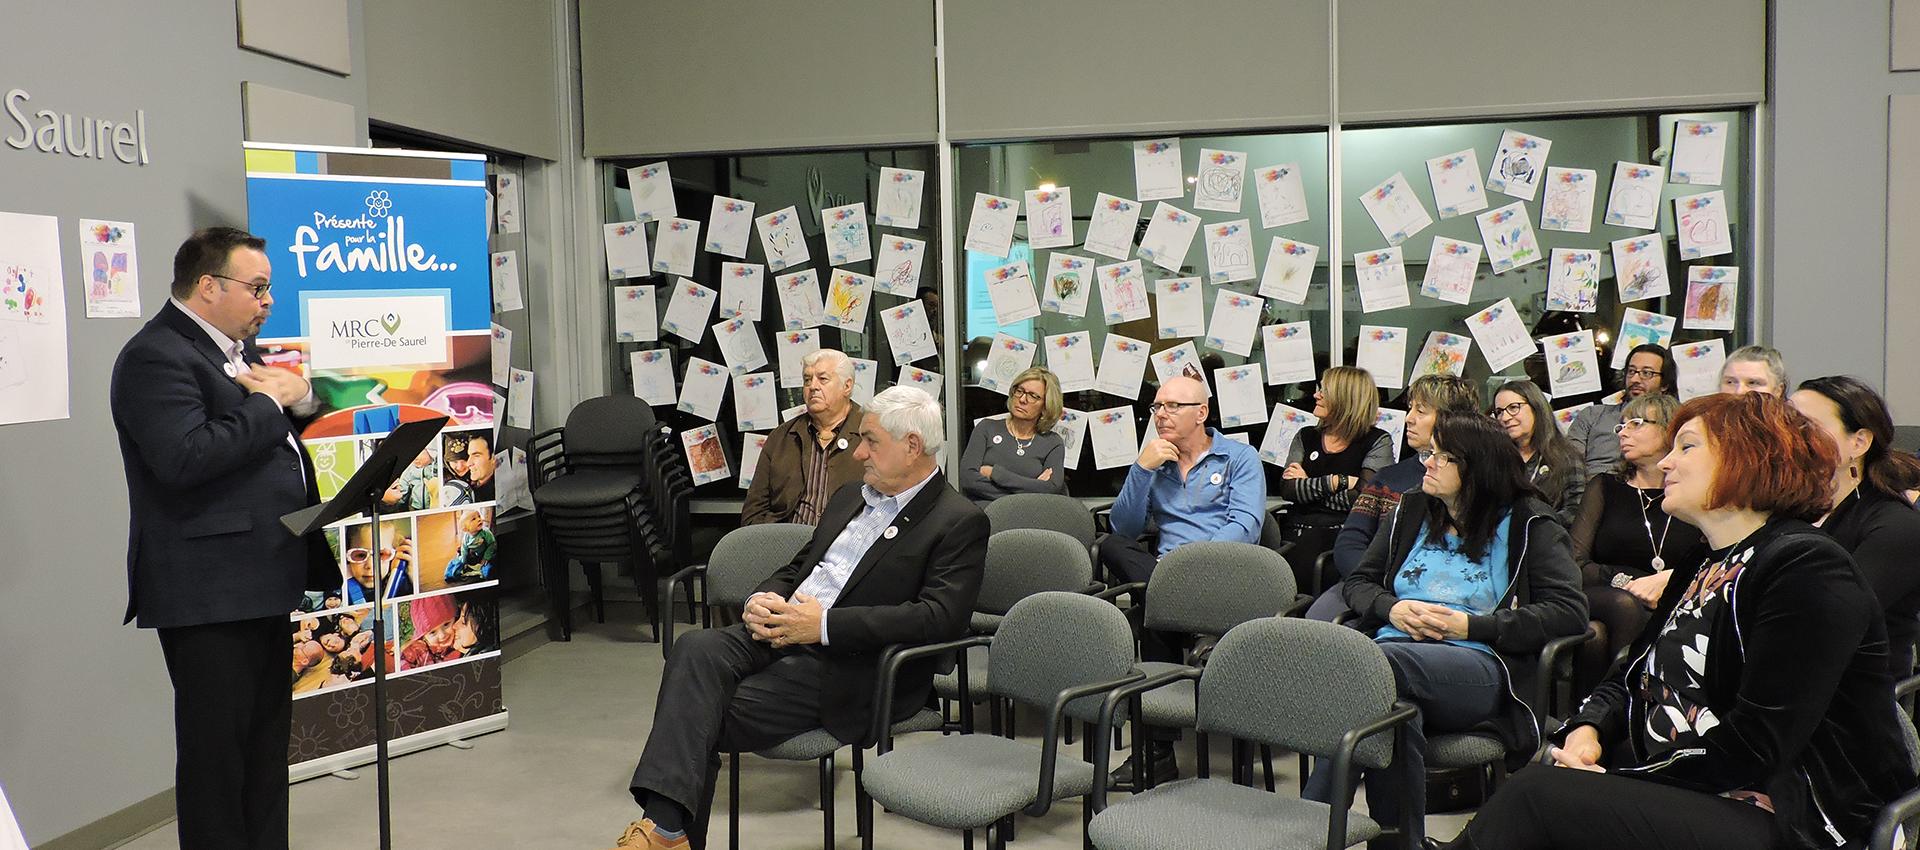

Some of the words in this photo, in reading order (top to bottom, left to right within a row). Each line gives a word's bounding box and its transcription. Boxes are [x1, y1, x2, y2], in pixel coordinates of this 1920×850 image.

[4, 89, 149, 166] Saurel
[314, 211, 376, 229] Présente
[289, 215, 457, 278] famille...
[345, 234, 364, 247] pour
[366, 230, 376, 243] la
[331, 319, 379, 338] MRC
[351, 338, 396, 349] Pierre-De
[399, 336, 427, 347] Saurel
